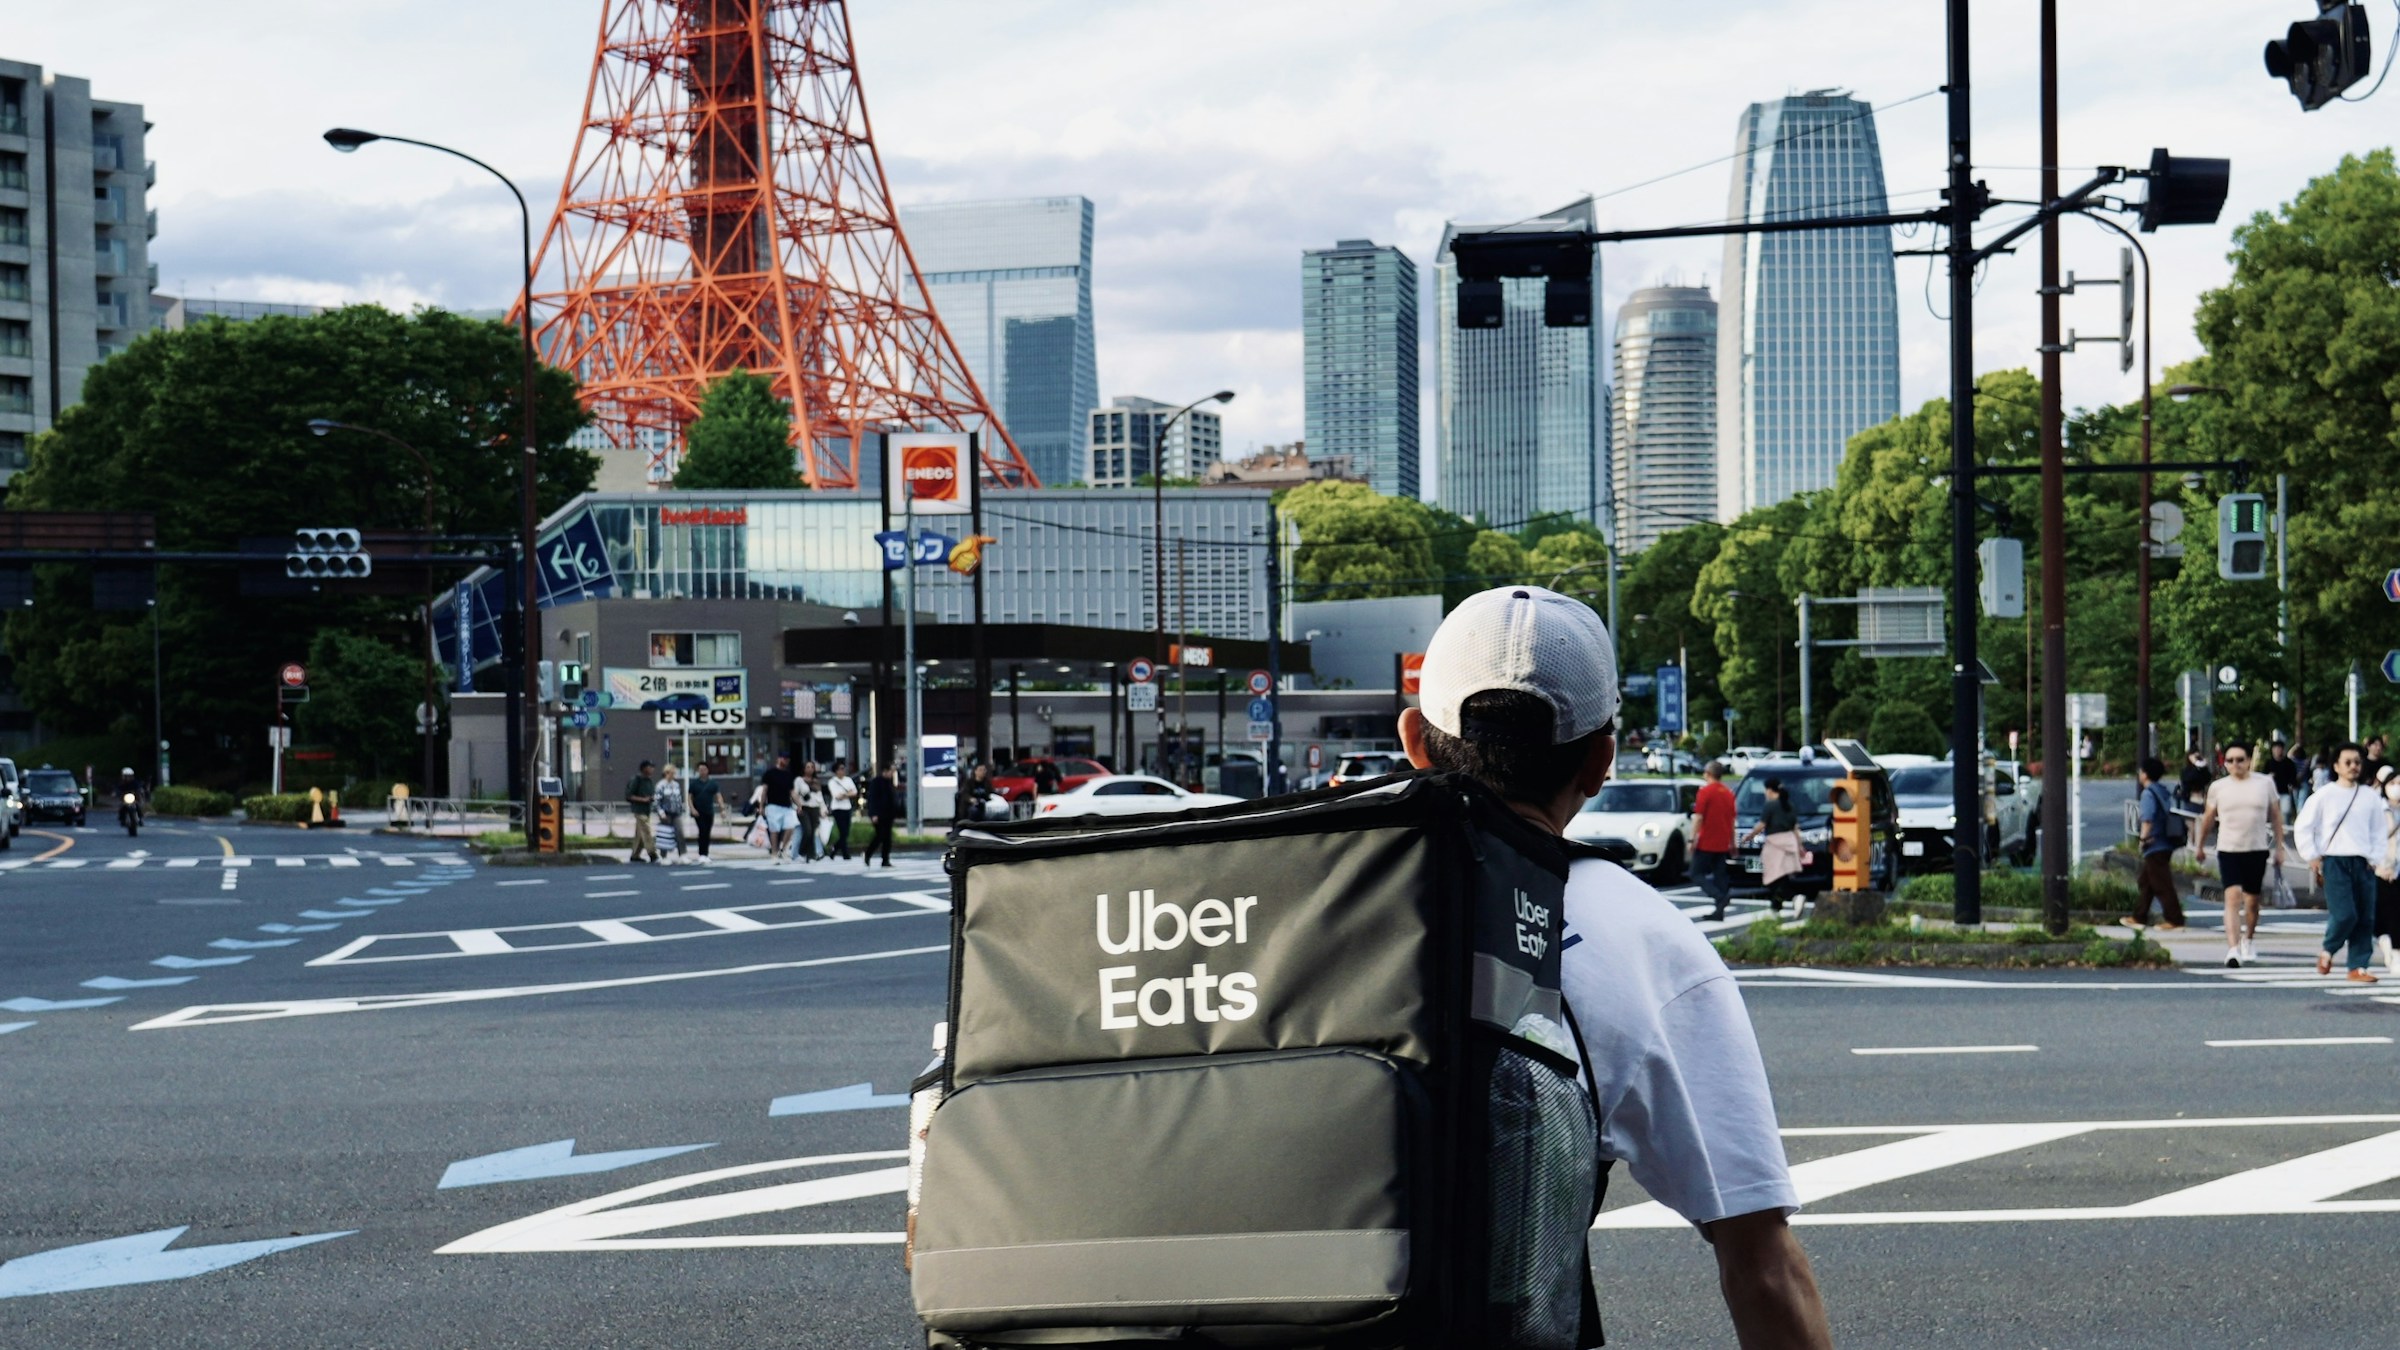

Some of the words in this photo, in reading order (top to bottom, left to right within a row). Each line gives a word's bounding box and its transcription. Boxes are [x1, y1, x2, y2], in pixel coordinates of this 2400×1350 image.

[905, 467, 954, 480] ENEOS
[661, 506, 747, 525] Iwatani
[1180, 647, 1210, 666] NEOS
[660, 709, 743, 724] ENEOS
[1513, 887, 1550, 929] Uber
[1096, 888, 1258, 955] Uber
[1098, 962, 1258, 1030] Eats
